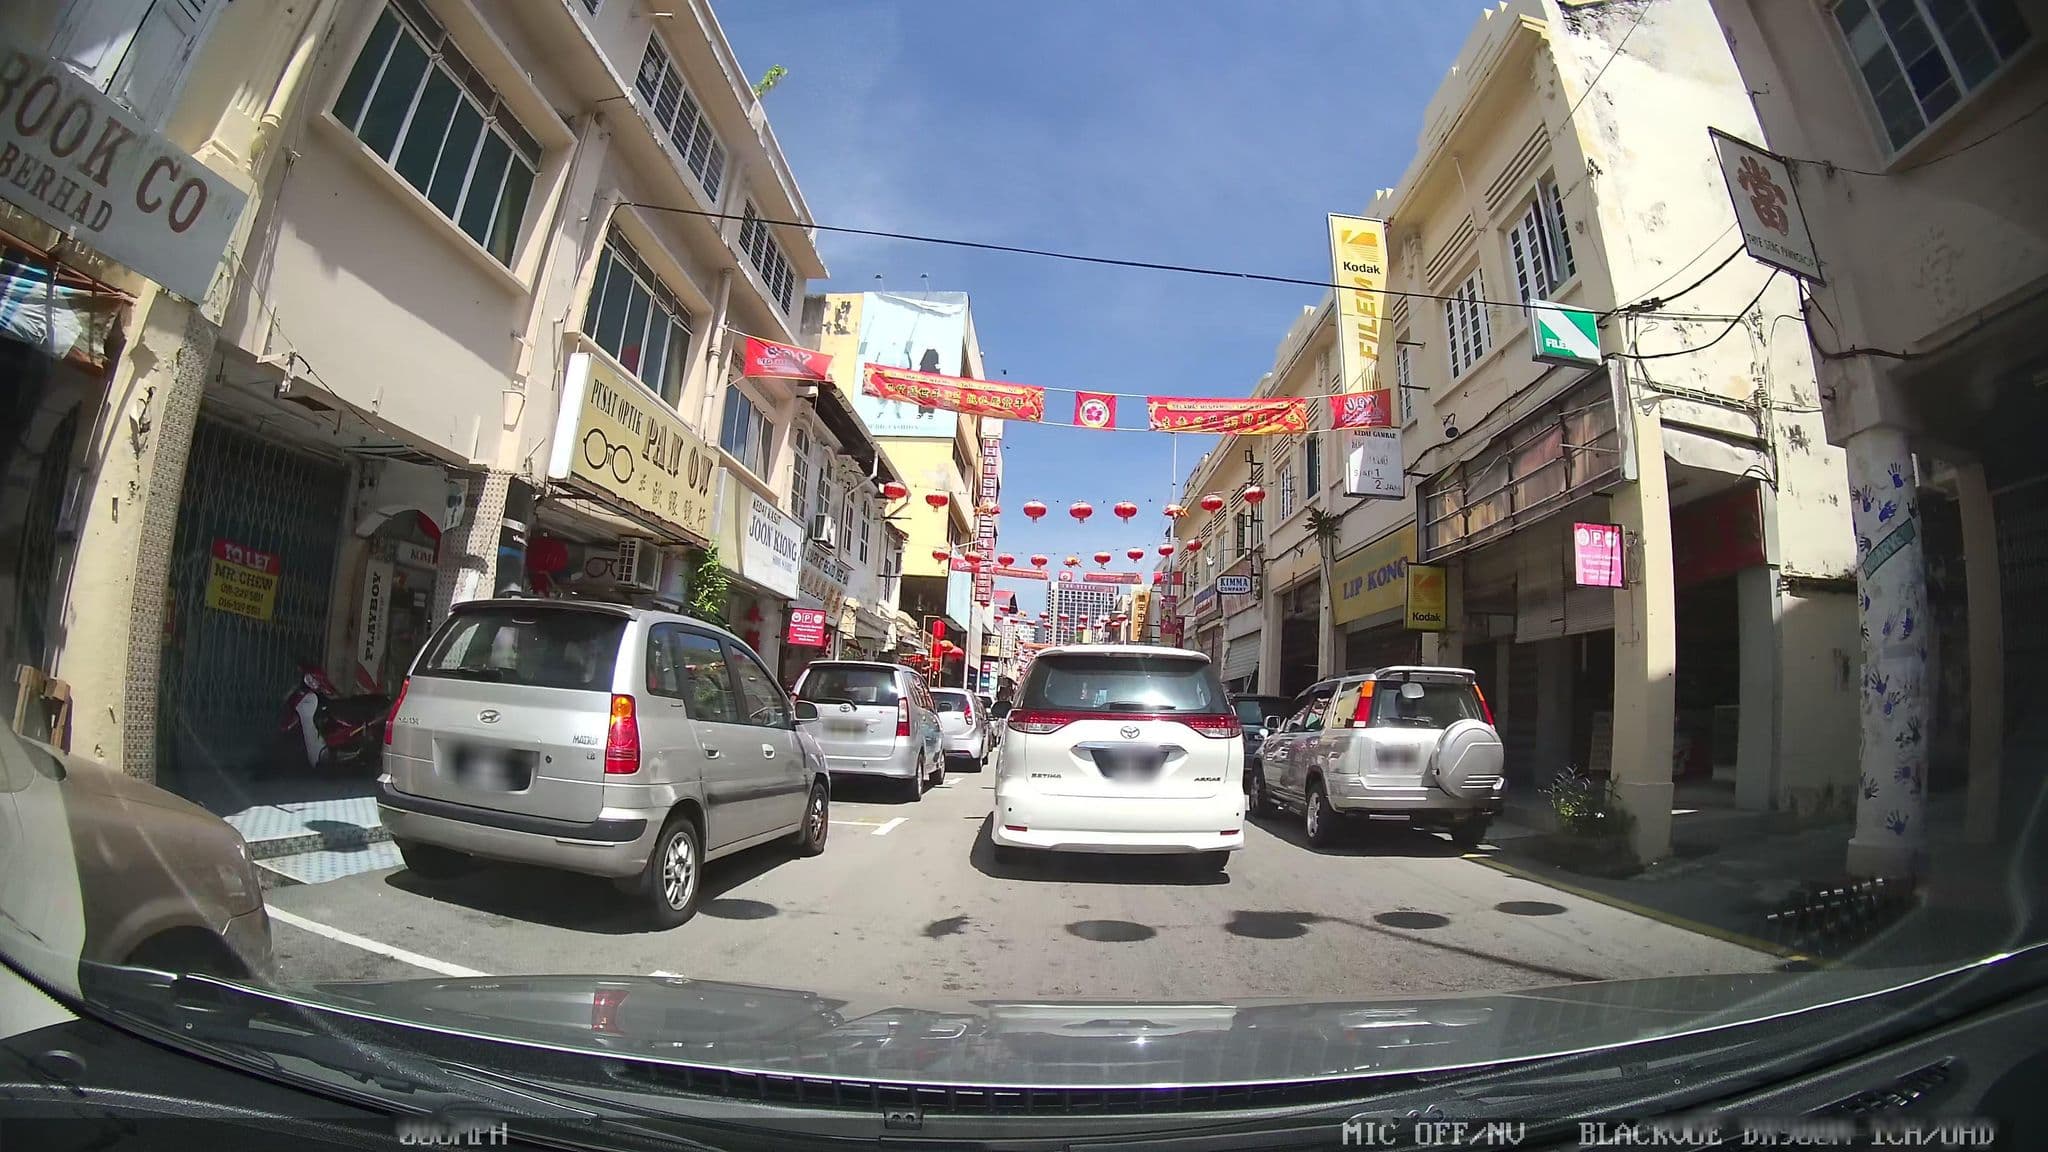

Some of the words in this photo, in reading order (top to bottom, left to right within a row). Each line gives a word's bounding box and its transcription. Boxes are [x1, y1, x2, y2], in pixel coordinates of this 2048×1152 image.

[0, 141, 113, 233] BERHAD
[136, 155, 209, 234] CO
[1343, 260, 1381, 275] Kodak
[1358, 277, 1380, 361] FILEM
[590, 378, 618, 418] PUSAT
[618, 402, 643, 436] OPTIK
[641, 415, 685, 477] PAN
[687, 445, 715, 498] OW
[224, 543, 243, 563] TO
[247, 551, 272, 572] LET
[749, 514, 774, 548] JOON
[773, 529, 798, 562] KIONG
[1220, 577, 1249, 587] KIMMA
[1342, 577, 1364, 600] LIP
[1366, 556, 1409, 593] KONG
[365, 571, 382, 662] PLAYBOY
[1412, 611, 1441, 623] Kodak
